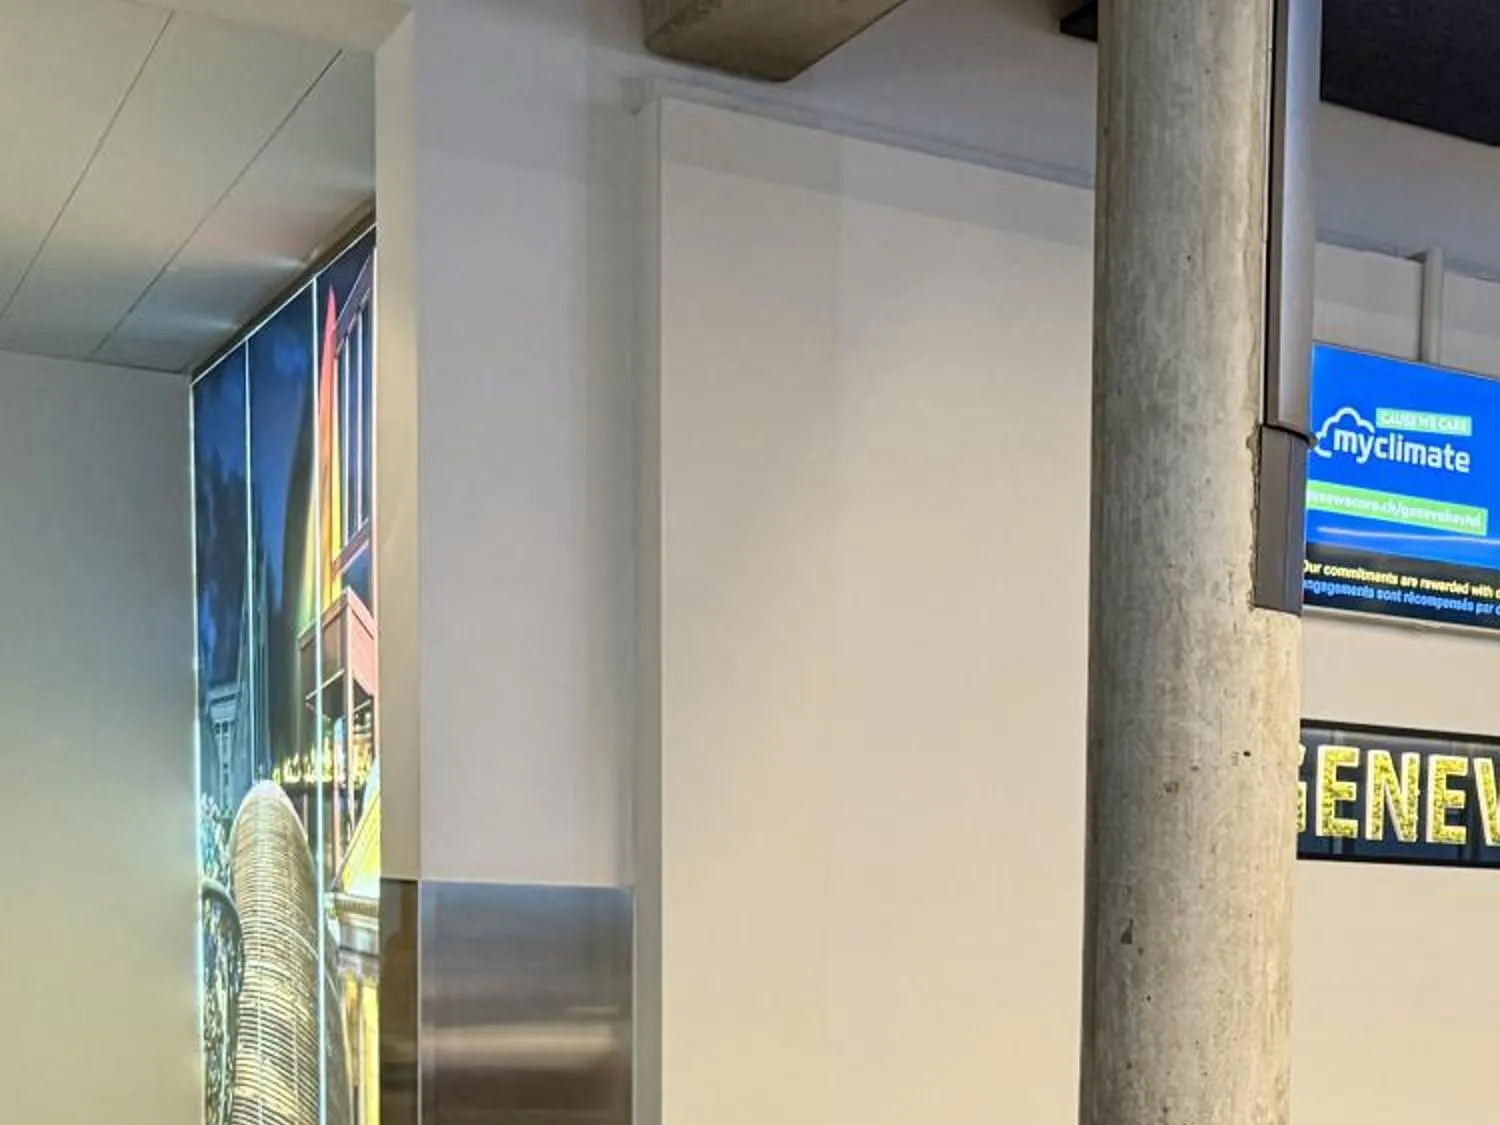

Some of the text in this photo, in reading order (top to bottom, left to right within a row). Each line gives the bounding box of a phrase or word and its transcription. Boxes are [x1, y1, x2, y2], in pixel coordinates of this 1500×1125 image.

[1333, 428, 1471, 473] myclimate
[1323, 564, 1399, 585] commitments
[1400, 575, 1418, 587] are
[1420, 577, 1469, 595] rewarded
[1471, 584, 1494, 598] with
[1376, 588, 1402, 602] sont
[1475, 602, 1493, 615] par
